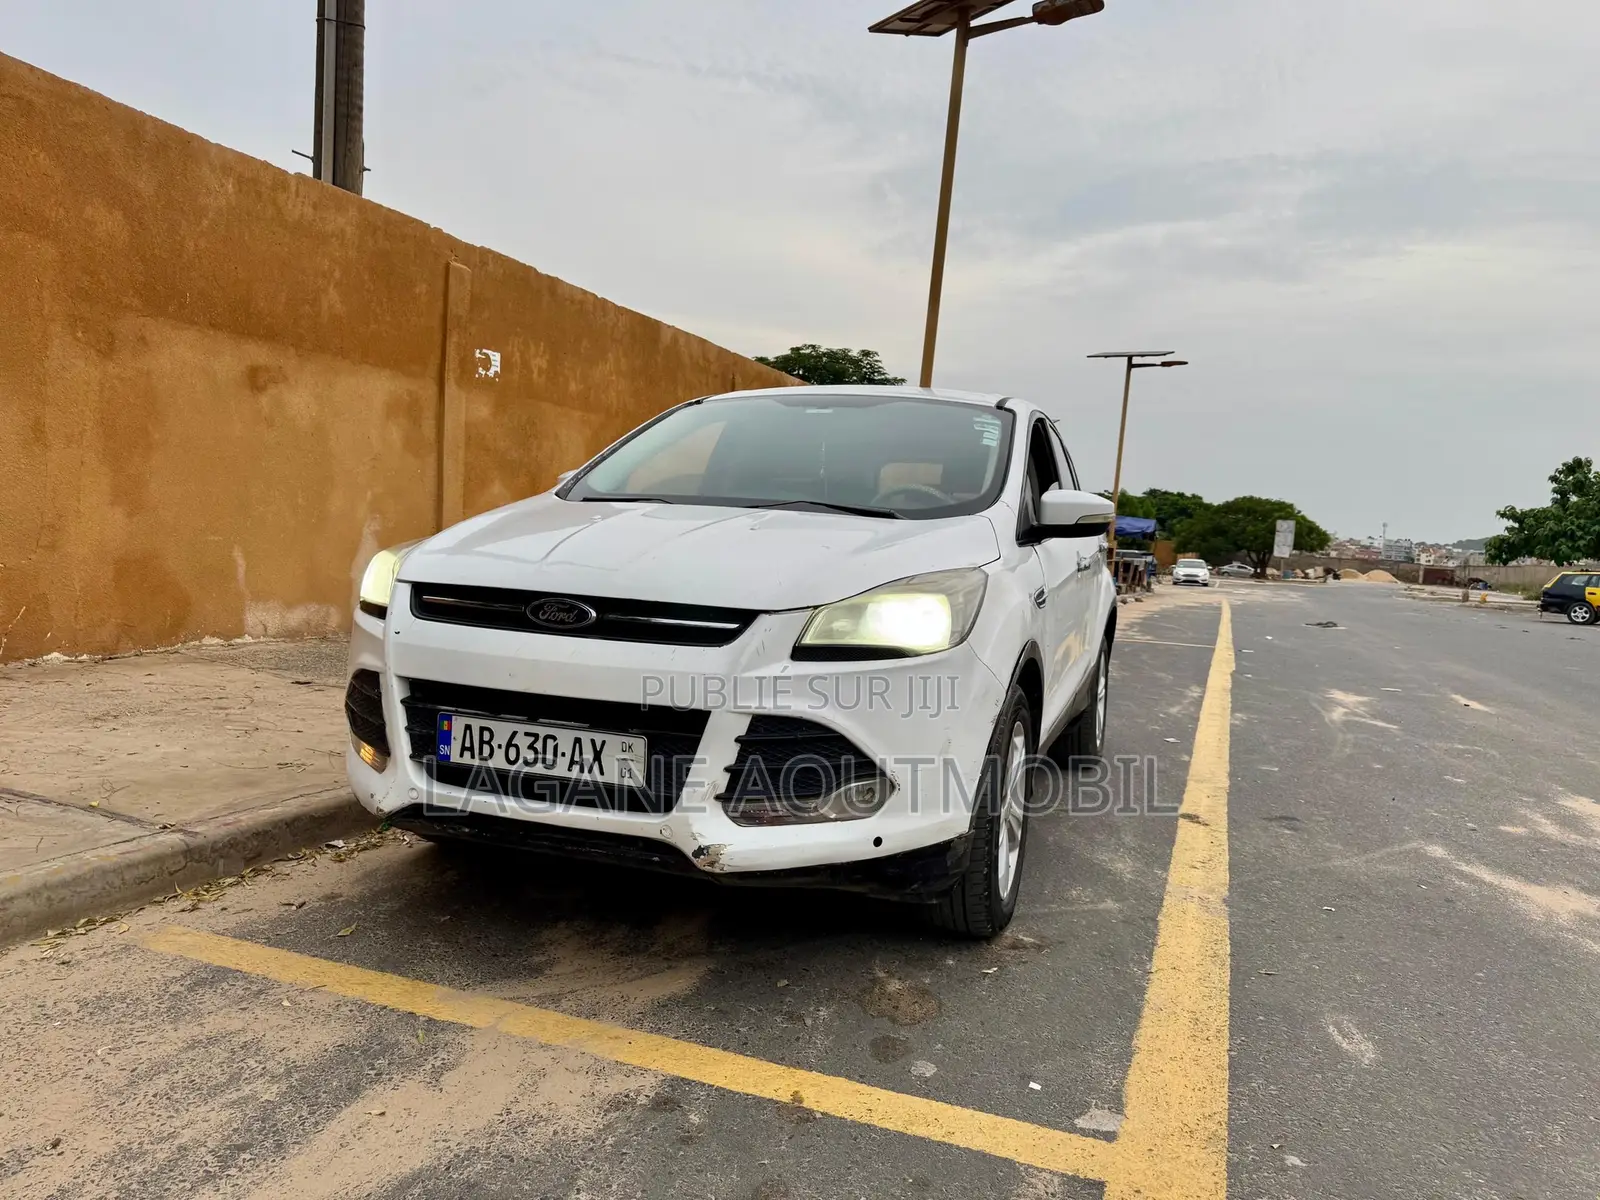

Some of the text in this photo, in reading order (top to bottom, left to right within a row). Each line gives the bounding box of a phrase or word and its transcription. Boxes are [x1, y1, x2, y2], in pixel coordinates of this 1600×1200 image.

[538, 602, 579, 623] Ford
[439, 744, 450, 756] SN
[621, 741, 634, 753] DK
